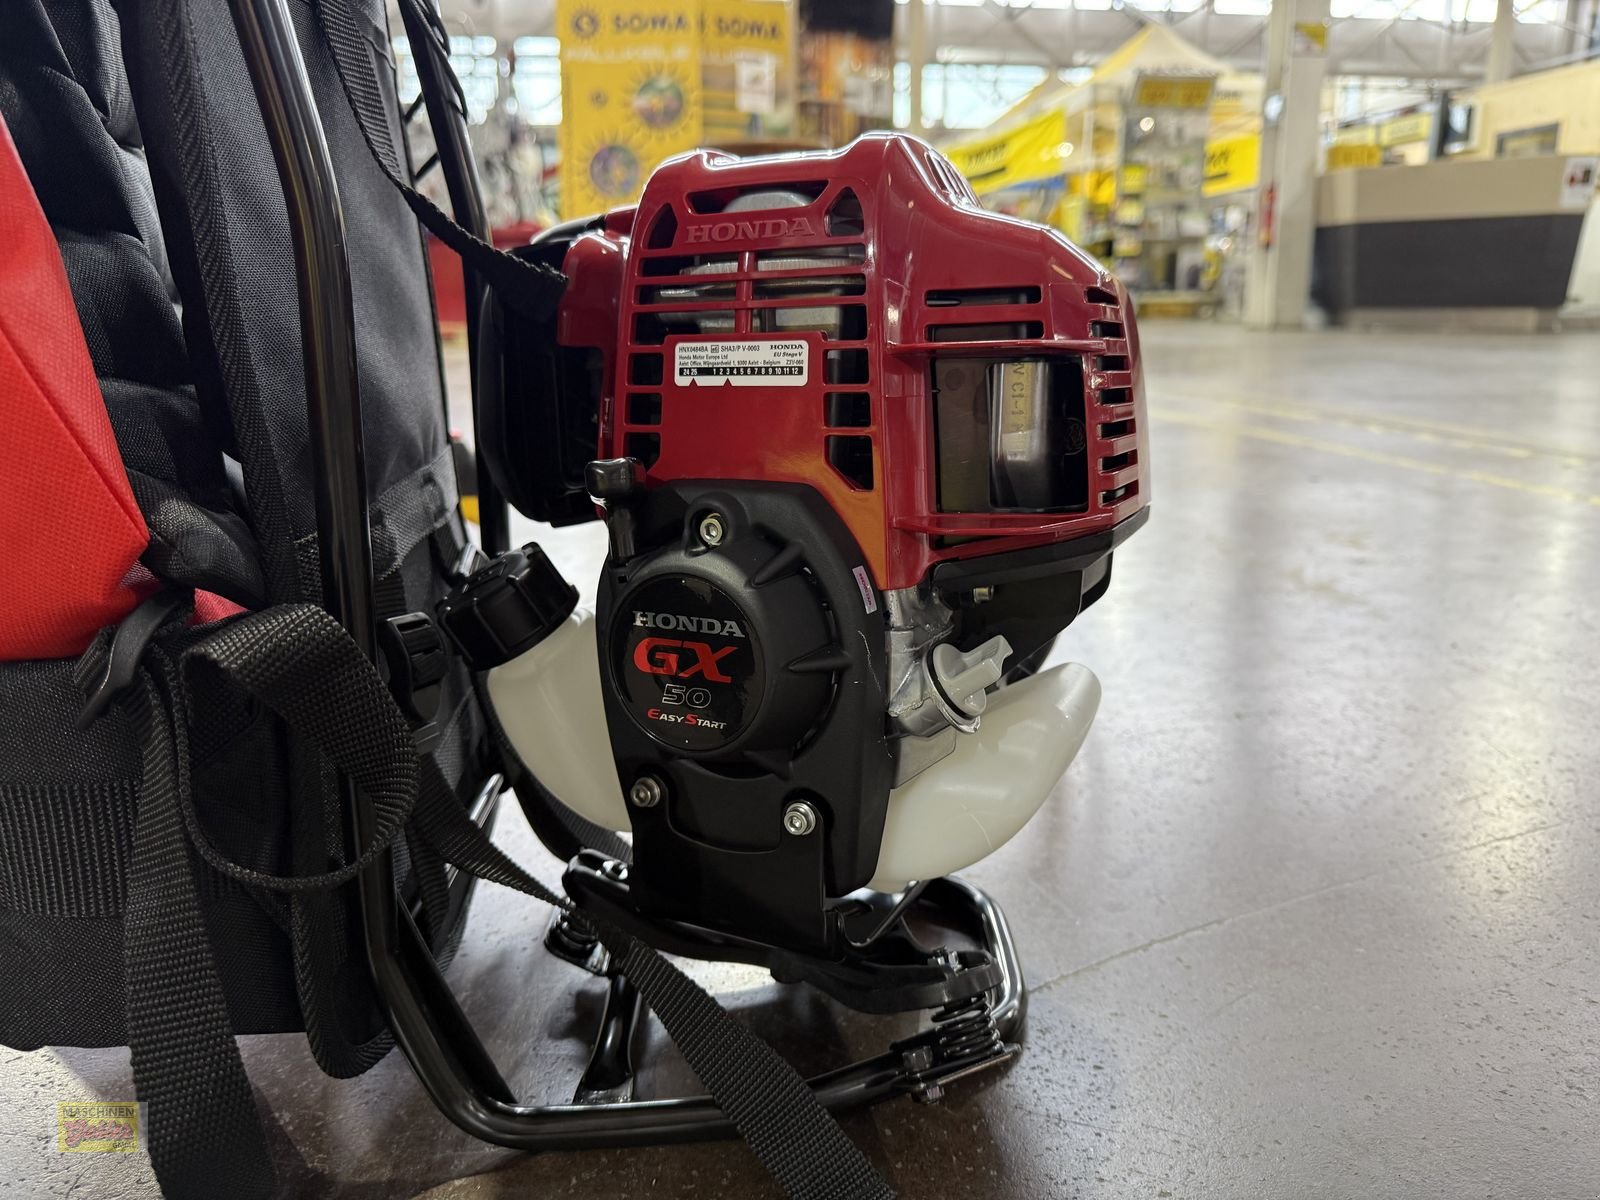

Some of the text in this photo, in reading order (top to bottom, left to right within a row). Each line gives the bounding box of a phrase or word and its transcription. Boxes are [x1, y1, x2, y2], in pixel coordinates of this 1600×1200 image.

[685, 217, 816, 243] HONDA
[632, 610, 745, 638] HONDA
[633, 637, 738, 684] GX
[662, 683, 711, 709] 50
